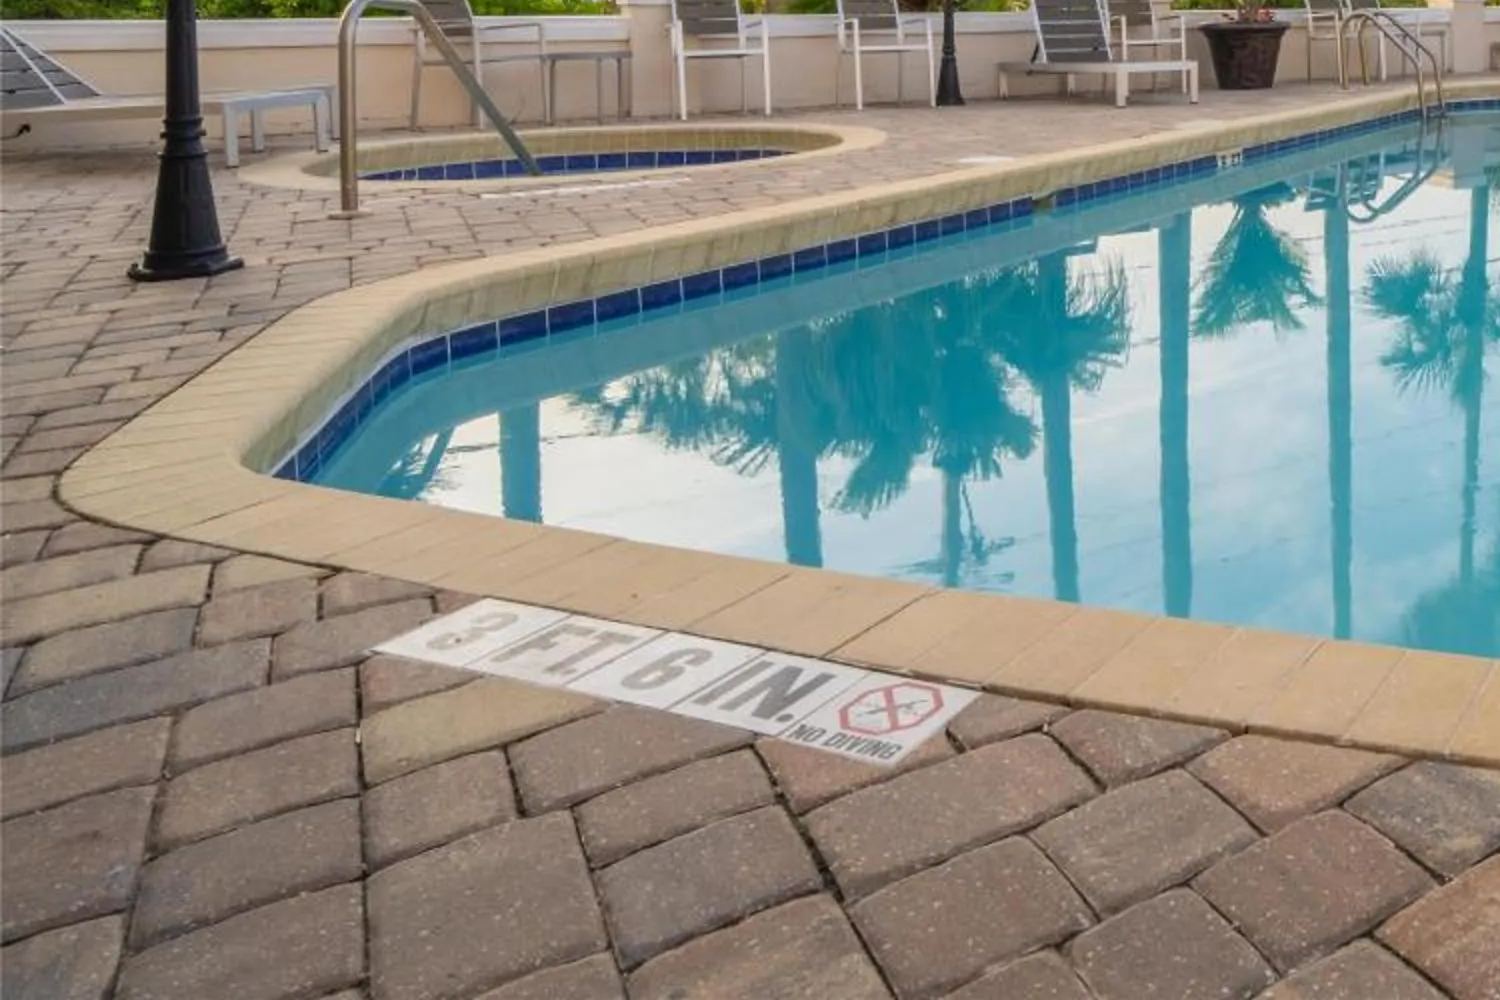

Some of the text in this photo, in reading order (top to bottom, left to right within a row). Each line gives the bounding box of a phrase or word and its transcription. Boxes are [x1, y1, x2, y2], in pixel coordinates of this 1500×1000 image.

[426, 611, 519, 651] 3
[620, 648, 713, 690] 6
[692, 659, 837, 723] IN.
[788, 723, 904, 760] NO DIVING
